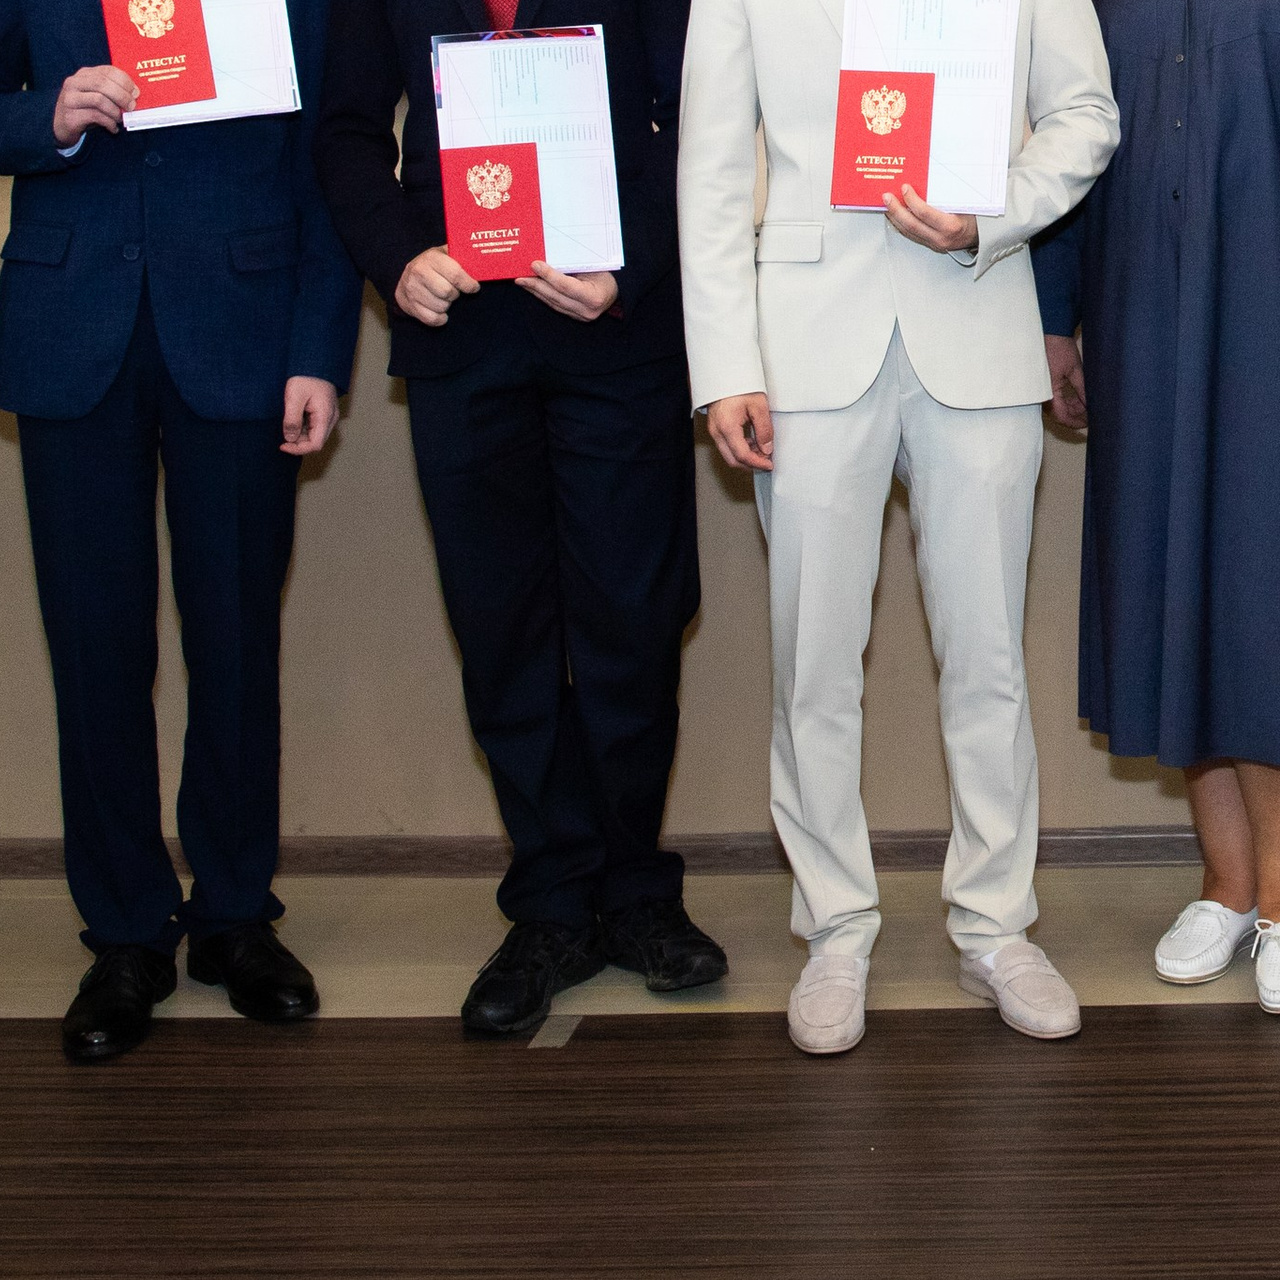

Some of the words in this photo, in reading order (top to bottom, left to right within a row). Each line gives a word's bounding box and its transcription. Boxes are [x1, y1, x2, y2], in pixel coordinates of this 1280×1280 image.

[136, 55, 186, 70] АТТЕСТАТ
[855, 155, 906, 165] АТТЕСТАТ
[470, 228, 520, 240] АТТЕСТАТ
